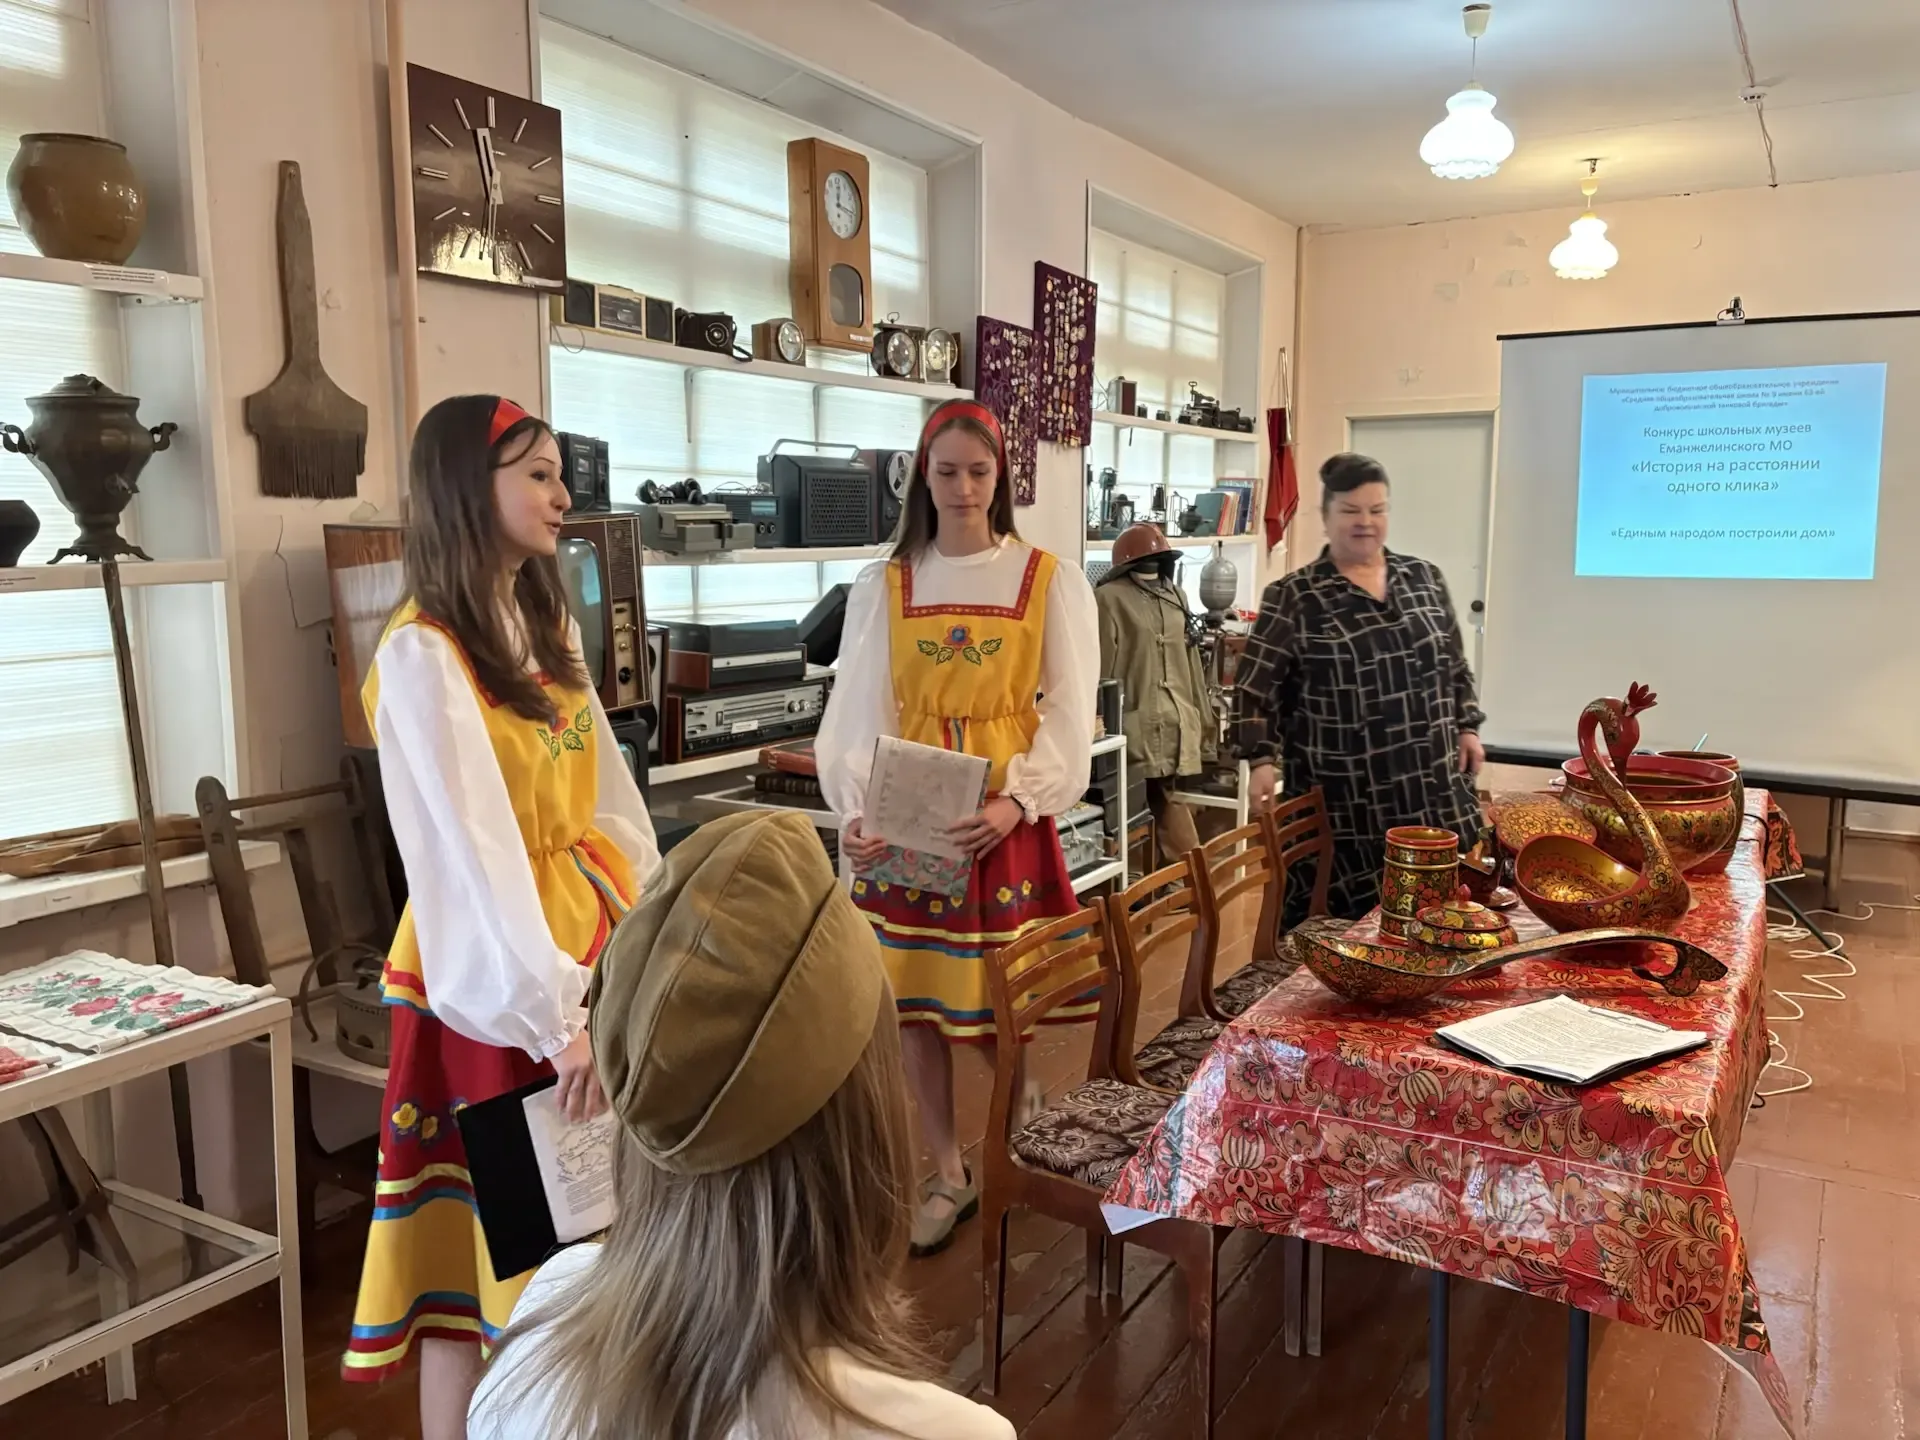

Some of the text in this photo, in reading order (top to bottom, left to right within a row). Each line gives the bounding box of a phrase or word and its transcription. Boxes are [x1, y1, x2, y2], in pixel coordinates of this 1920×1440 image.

[1643, 423, 1812, 440] Конкурс школьных музеев
[1659, 439, 1793, 454] Еманжелинского МО
[1631, 459, 1820, 475] «История на расстоянии
[1667, 480, 1779, 494] одного клика»
[1610, 527, 1836, 540] «Единым народом построили дом»
